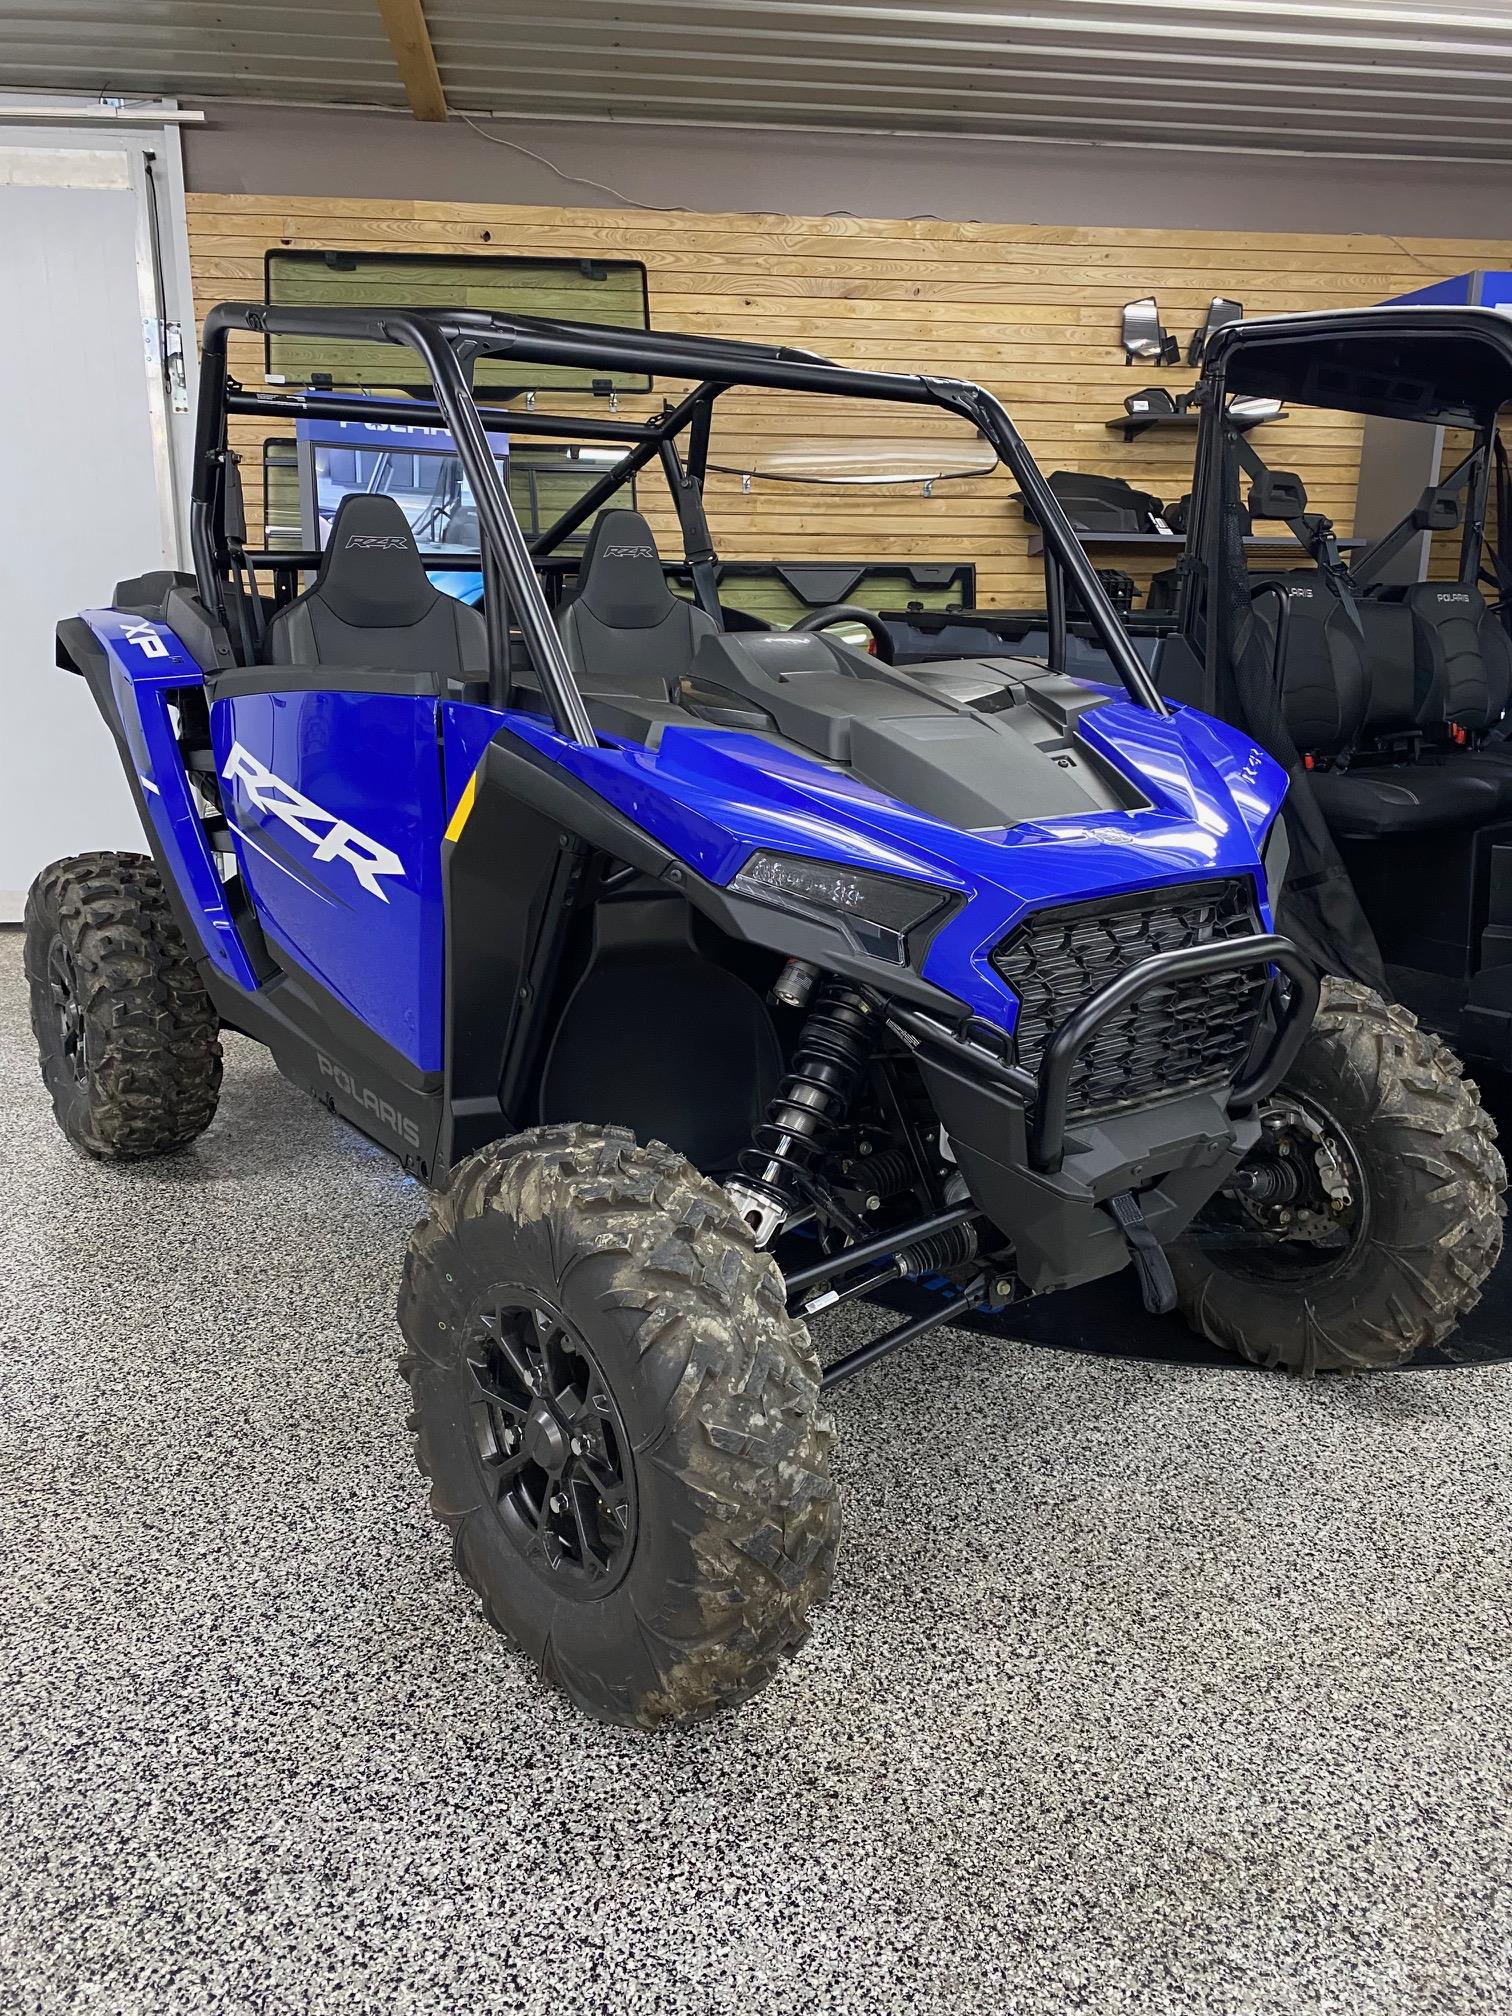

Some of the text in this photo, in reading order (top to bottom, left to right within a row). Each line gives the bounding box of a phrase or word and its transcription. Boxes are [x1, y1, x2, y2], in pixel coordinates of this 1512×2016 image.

[344, 535, 408, 549] RZR
[603, 545, 653, 558] RZR
[1437, 593, 1470, 602] POLARIS
[119, 621, 170, 659] XP
[222, 740, 406, 905] RZR
[317, 1051, 420, 1149] POLARIS
